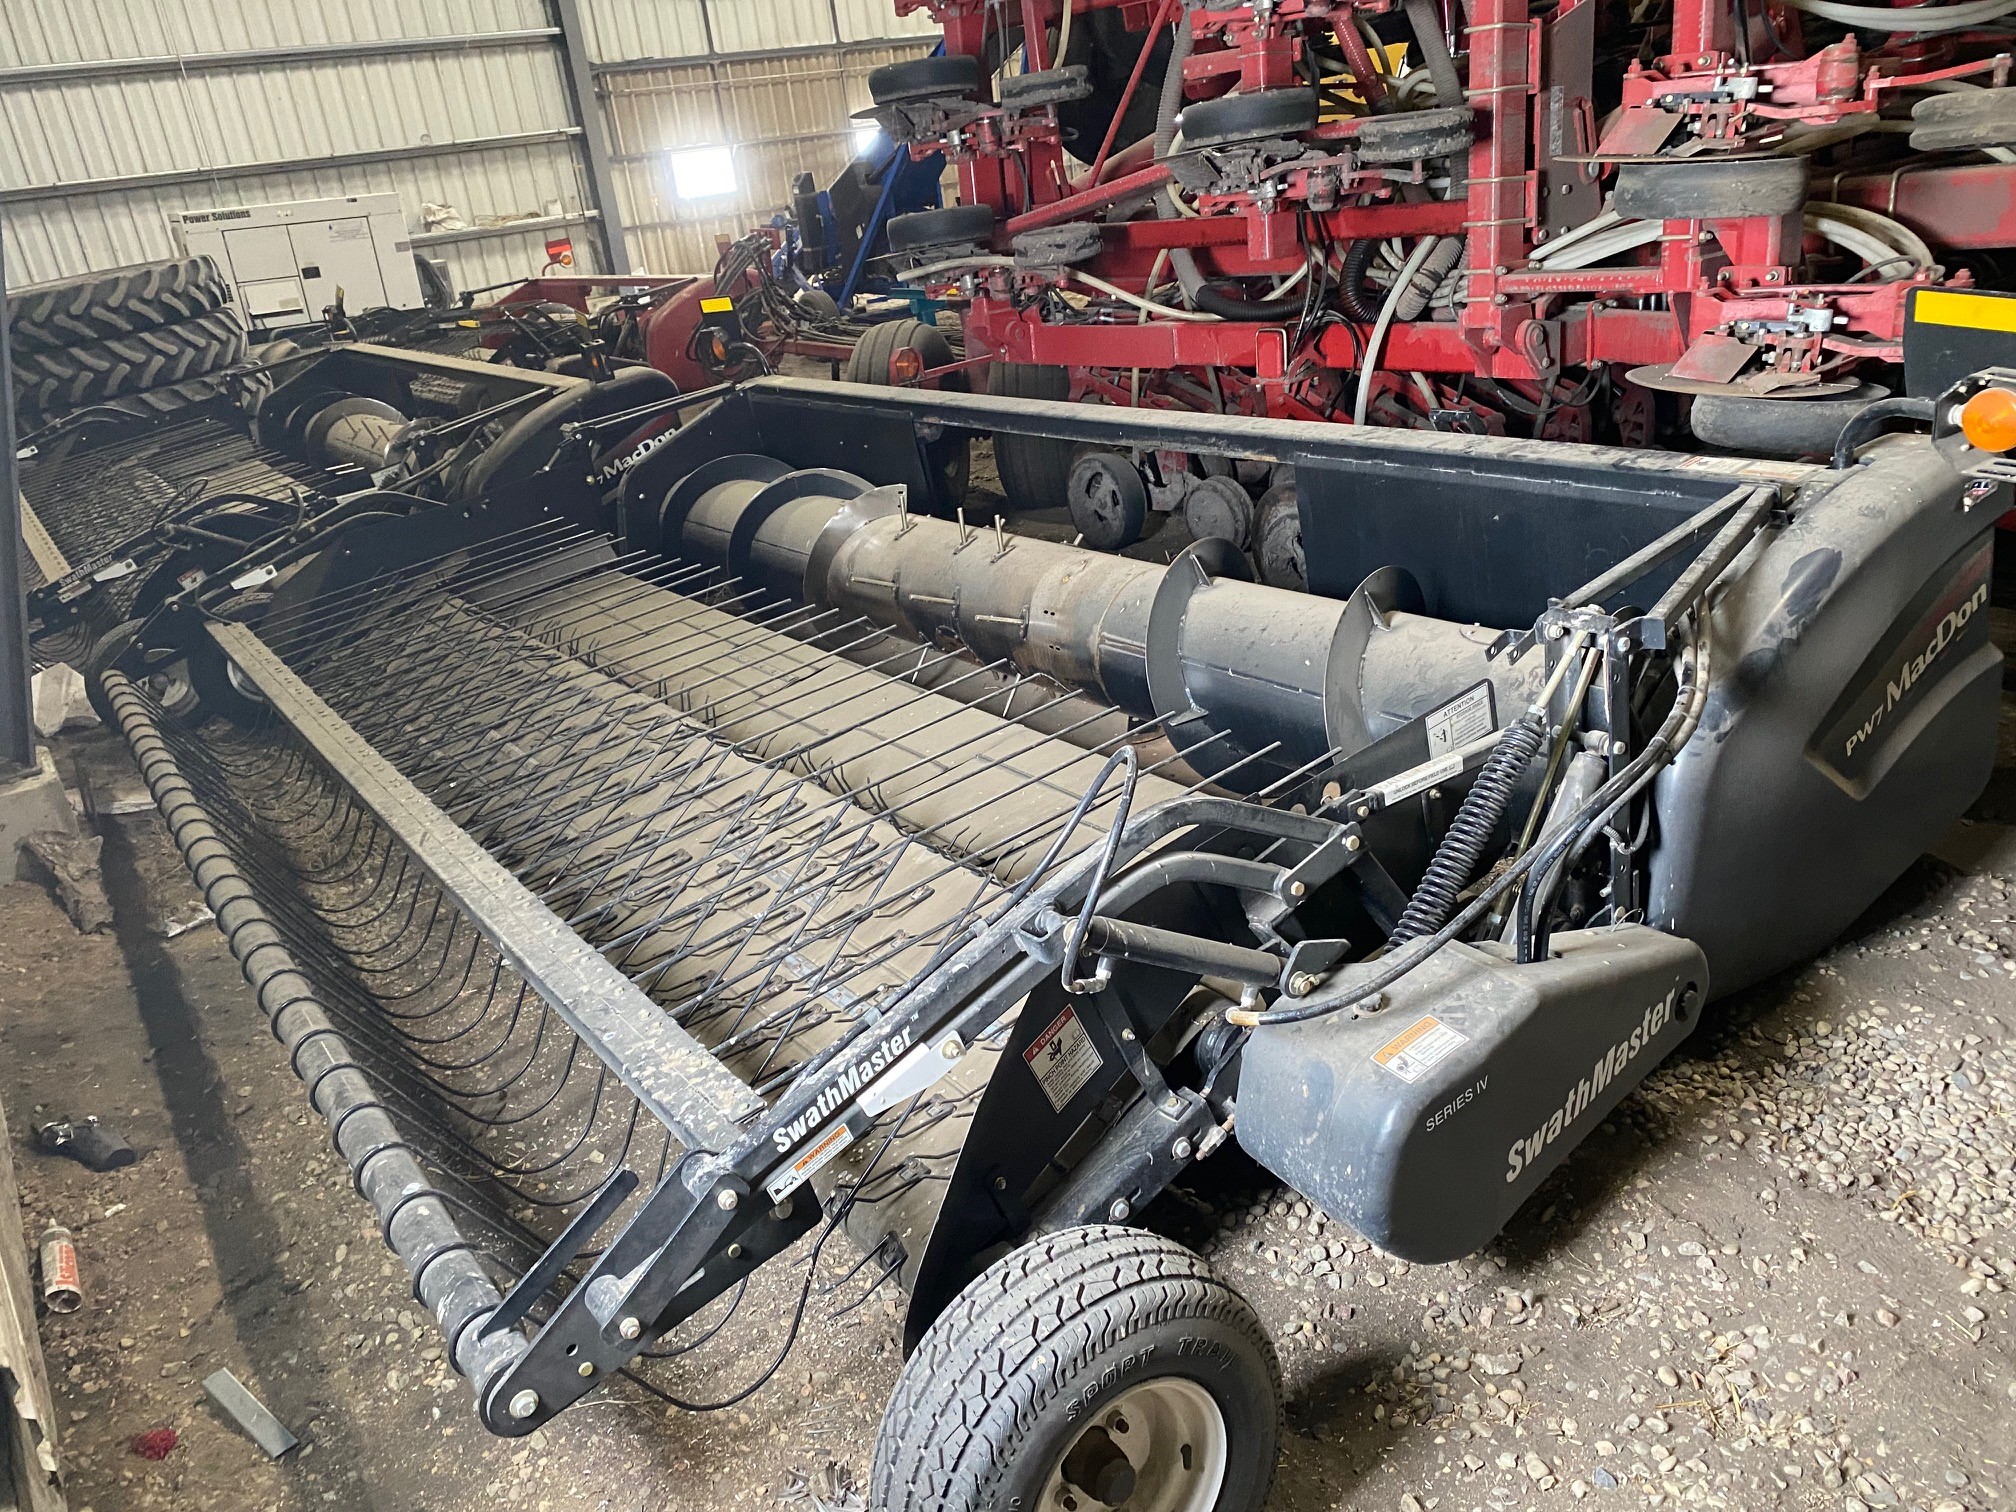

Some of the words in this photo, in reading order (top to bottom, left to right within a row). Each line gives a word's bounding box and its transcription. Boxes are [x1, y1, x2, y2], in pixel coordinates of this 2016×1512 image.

[182, 213, 210, 224] Power
[212, 210, 251, 221] Solutions
[602, 428, 677, 479] MacDon
[58, 552, 113, 587] SwathMaster
[1845, 704, 1884, 757] PW7
[1886, 583, 1987, 712] MacDon
[1443, 695, 1475, 718] ATTENTION
[1040, 1015, 1067, 1045] DANGER
[1067, 1036, 1086, 1057] HAZARD
[1391, 1021, 1432, 1050] WARNING
[773, 1026, 911, 1153] SwathMaster
[1505, 988, 1676, 1183] SwathMaster
[1426, 1088, 1474, 1132] SERIES
[1476, 1075, 1489, 1094] IV
[808, 1131, 842, 1161] WARNING
[1065, 1344, 1155, 1422] SPORT
